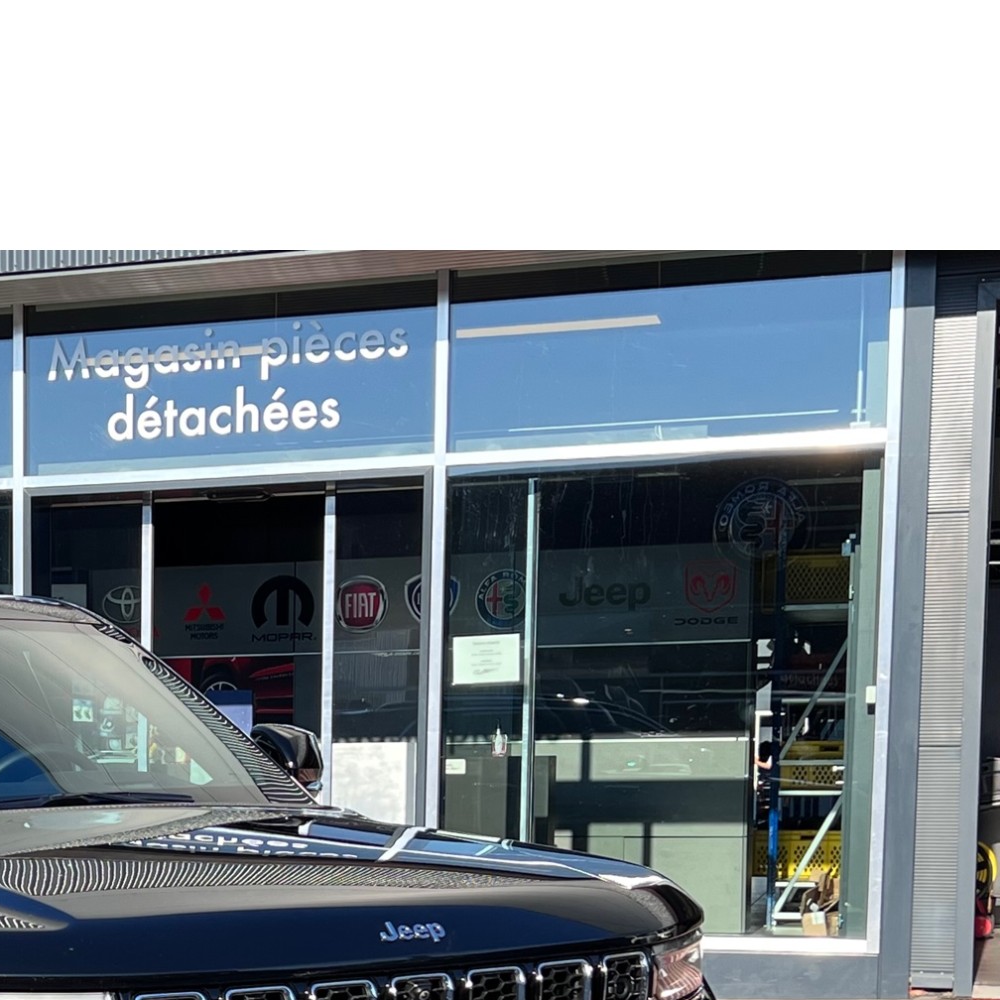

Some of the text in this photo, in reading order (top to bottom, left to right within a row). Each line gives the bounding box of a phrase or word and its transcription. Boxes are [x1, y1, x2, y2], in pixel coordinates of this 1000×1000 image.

[47, 321, 408, 389] Magasin pièces
[107, 386, 340, 442] détachées
[344, 592, 377, 618] FIAT
[559, 575, 651, 611] Jeep
[674, 616, 739, 626] DODGE
[251, 632, 313, 642] MOPAR
[380, 921, 446, 942] Jeep
